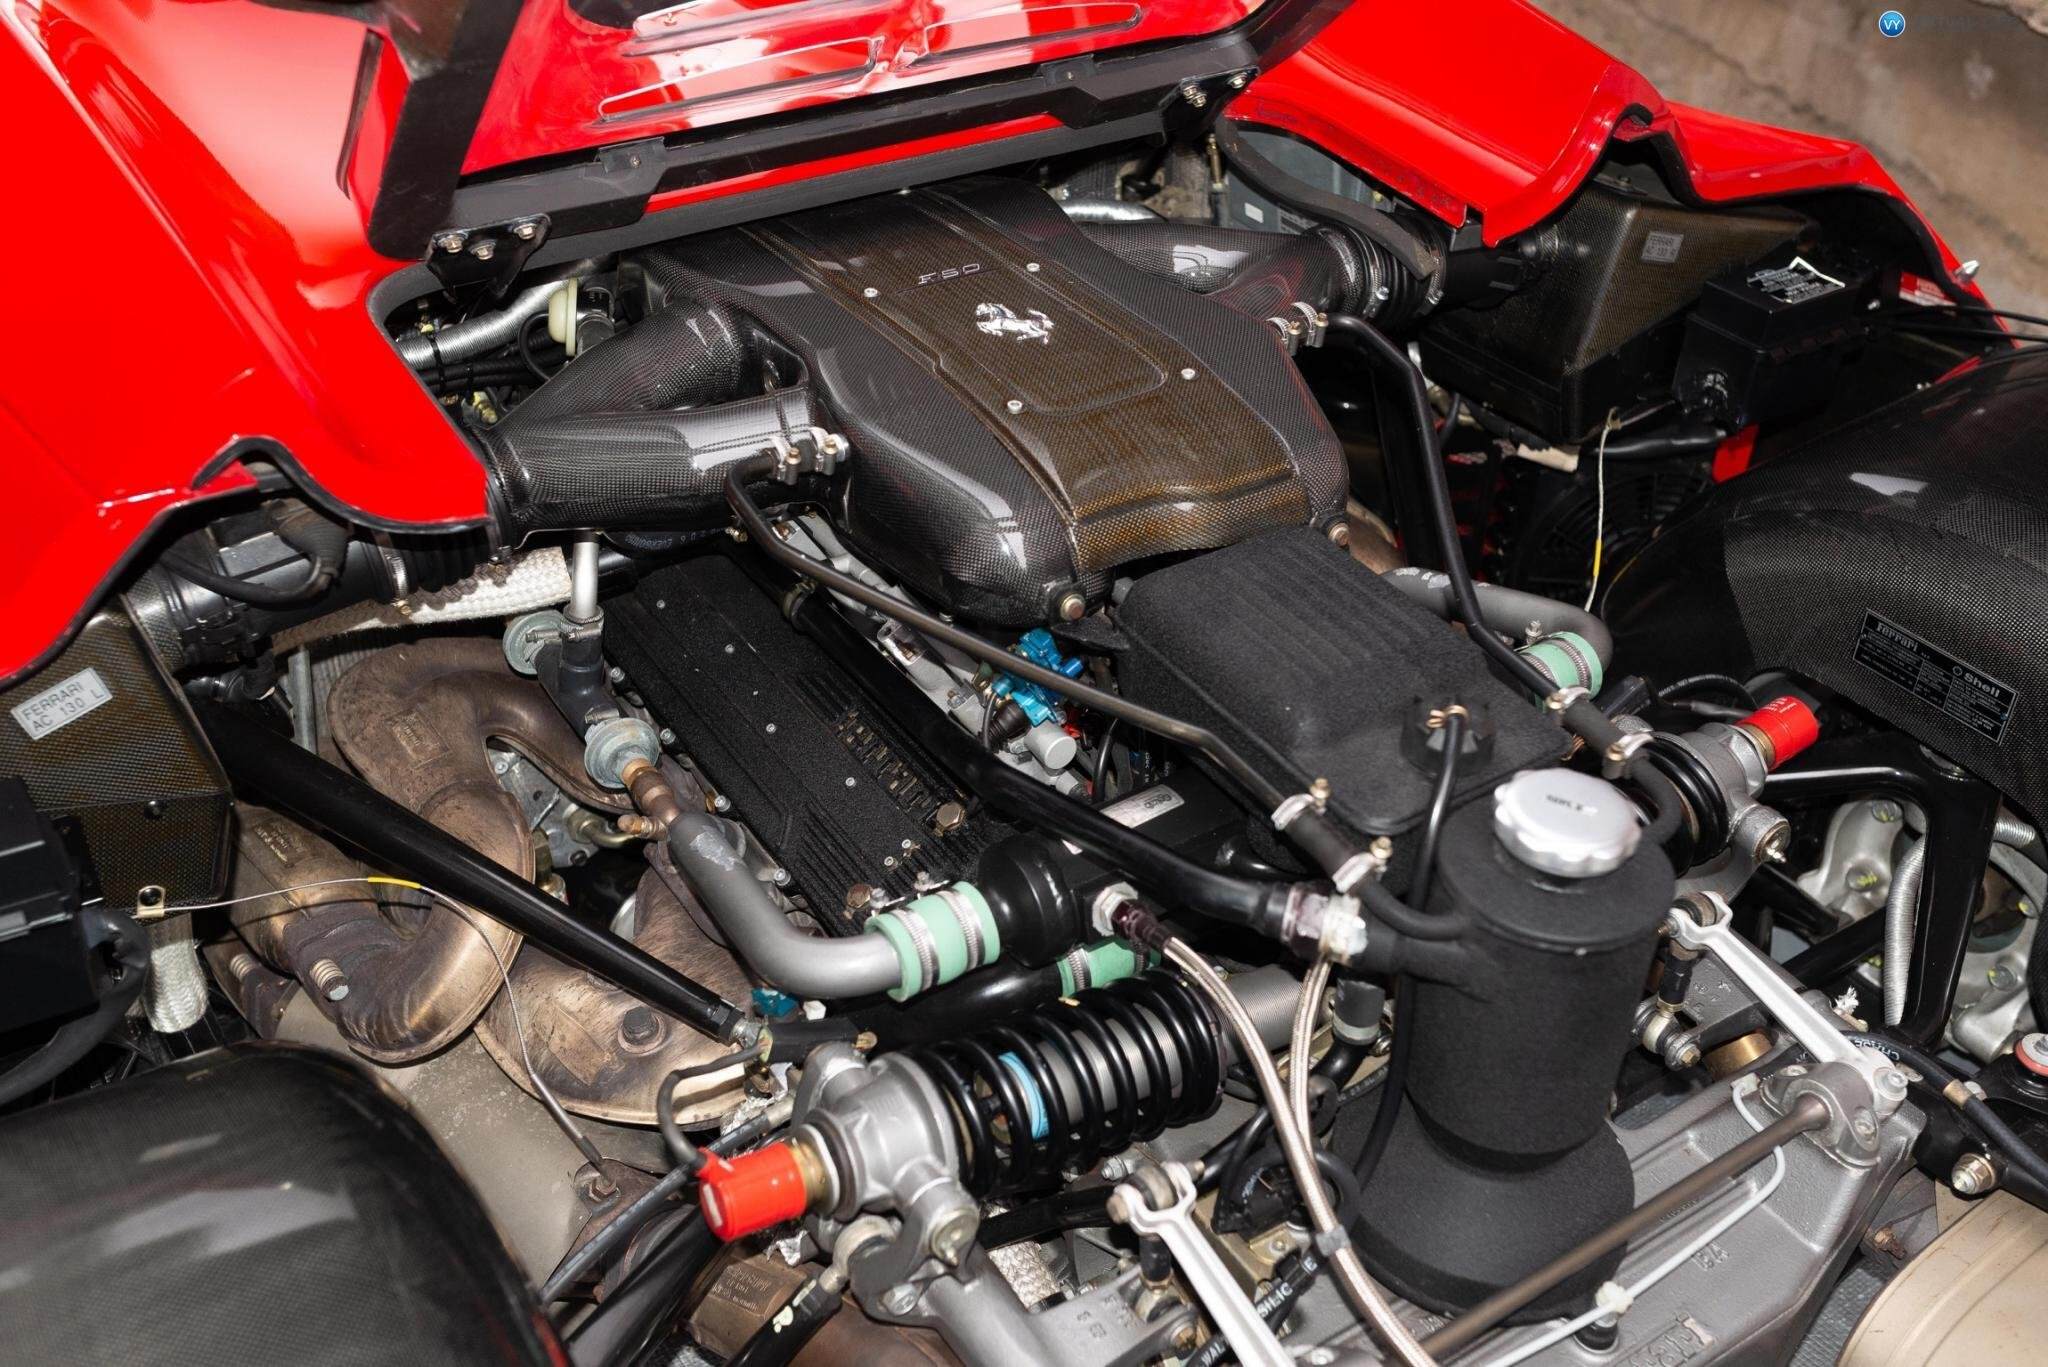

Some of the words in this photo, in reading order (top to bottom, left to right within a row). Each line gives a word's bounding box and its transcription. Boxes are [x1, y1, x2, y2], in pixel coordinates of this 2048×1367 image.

[1876, 622, 1918, 651] Ferrari
[22, 681, 83, 720] FERRARI
[1963, 672, 2000, 698] Shell
[33, 714, 53, 732] AC
[60, 697, 85, 715] 130
[90, 689, 104, 699] L
